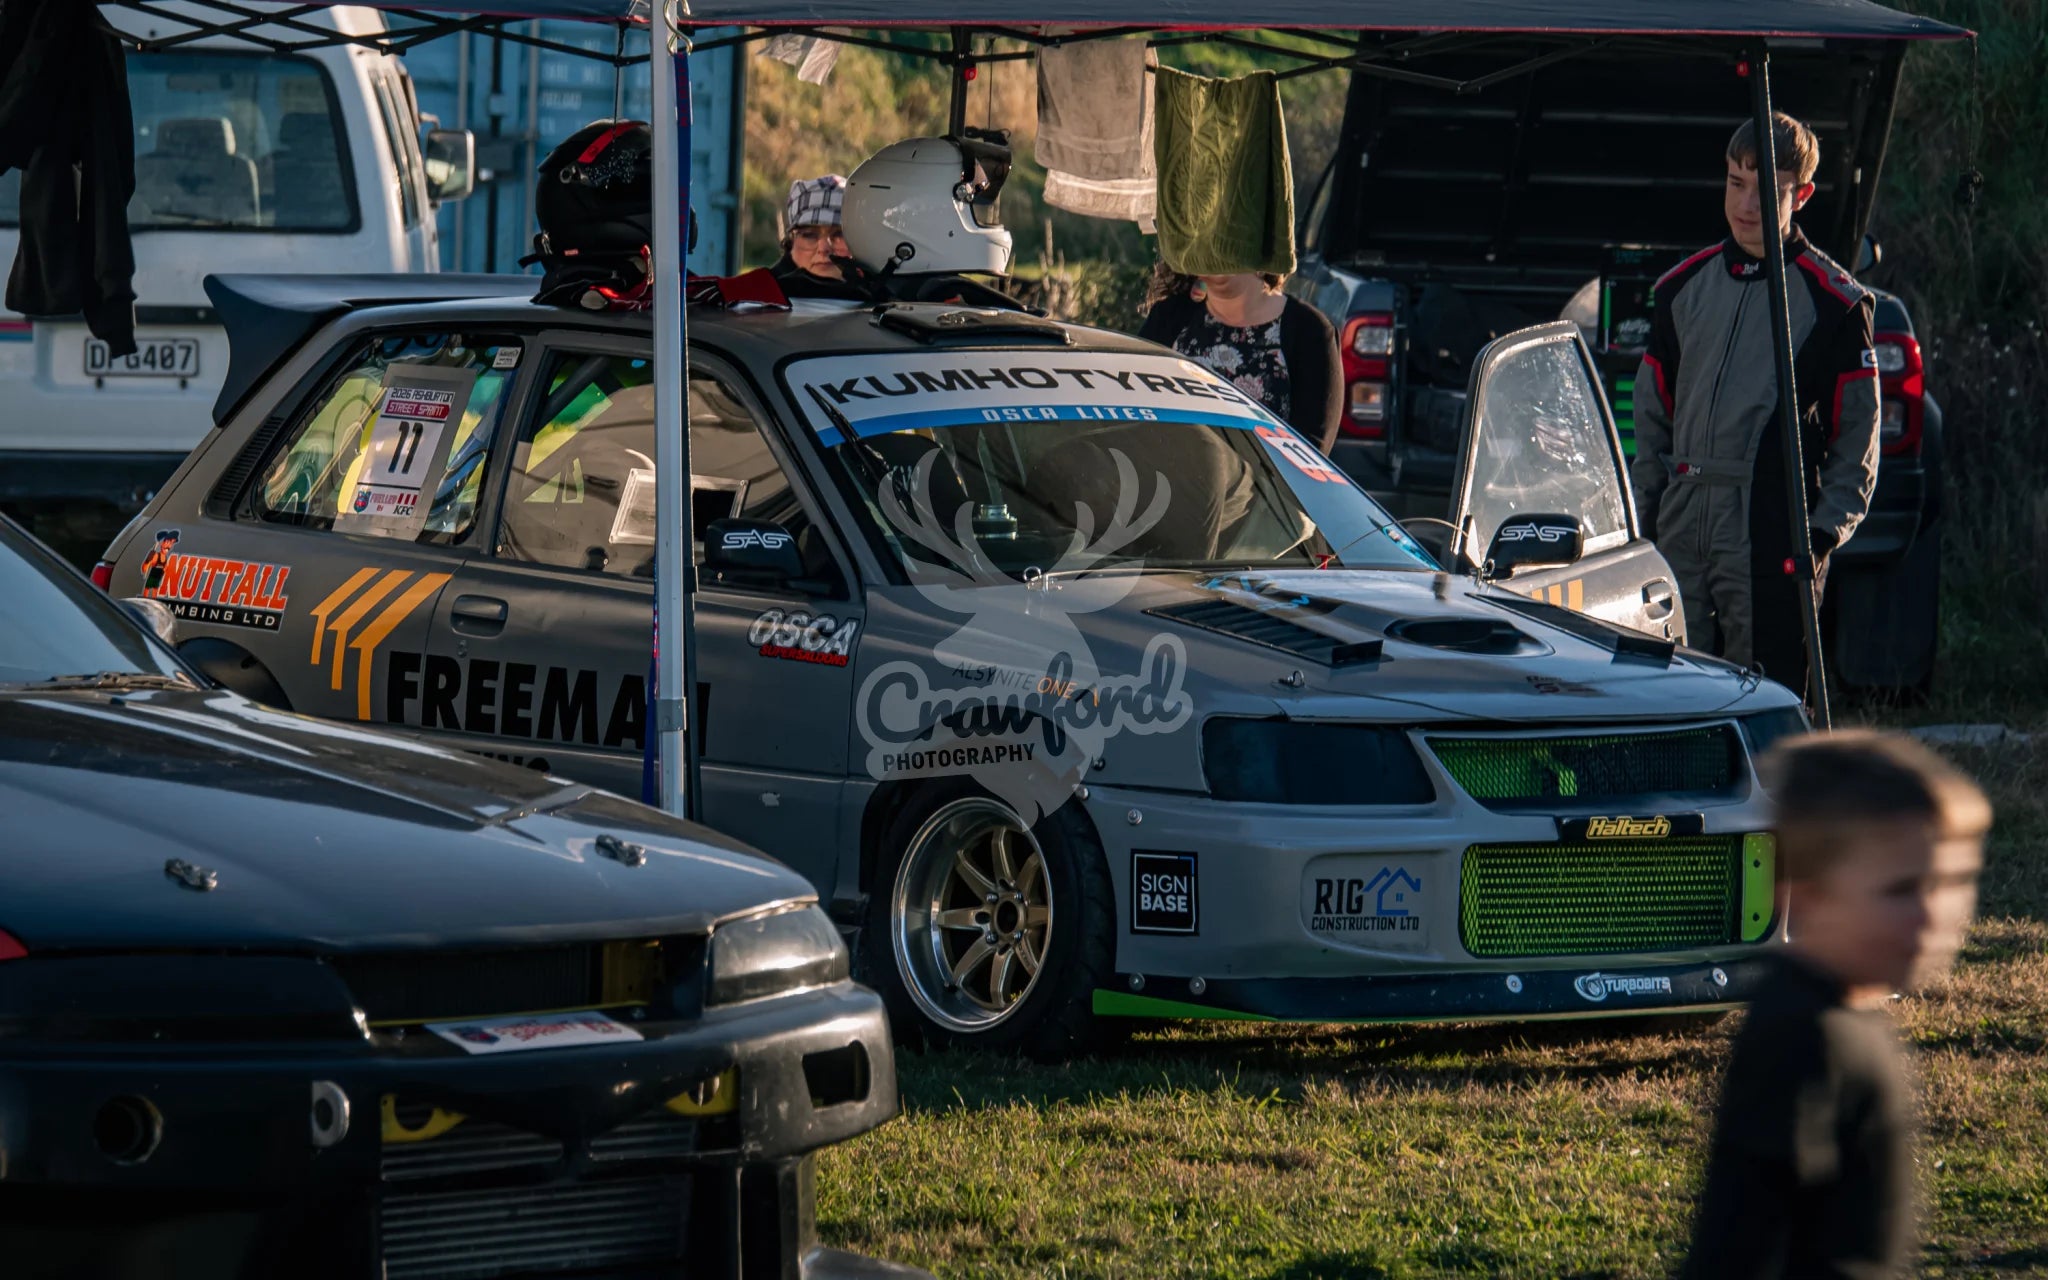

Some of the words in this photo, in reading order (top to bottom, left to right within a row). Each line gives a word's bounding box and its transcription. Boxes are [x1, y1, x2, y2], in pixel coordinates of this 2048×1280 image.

[90, 344, 192, 370] DG407
[391, 387, 411, 399] 2026
[412, 389, 454, 402] ASHBURTON
[387, 401, 417, 414] STREET
[417, 404, 444, 418] SPRINT
[981, 407, 1058, 422] OSCA
[1075, 406, 1159, 421] LITES
[387, 420, 423, 475] 11
[393, 505, 414, 516] KFC
[158, 554, 291, 611] NUTTALL
[242, 613, 276, 627] LTD
[748, 608, 859, 656] OSCA
[952, 661, 1037, 692] ALSYNITE
[1037, 676, 1078, 701] ONE
[1588, 816, 1671, 838] Haltech
[1141, 873, 1188, 894] SIGN
[1141, 893, 1188, 913] BASE
[1313, 879, 1365, 916] RIG
[1311, 915, 1397, 932] CONSTRUCTION
[1399, 916, 1420, 932] LTD
[1605, 976, 1672, 996] TURBOBITS
